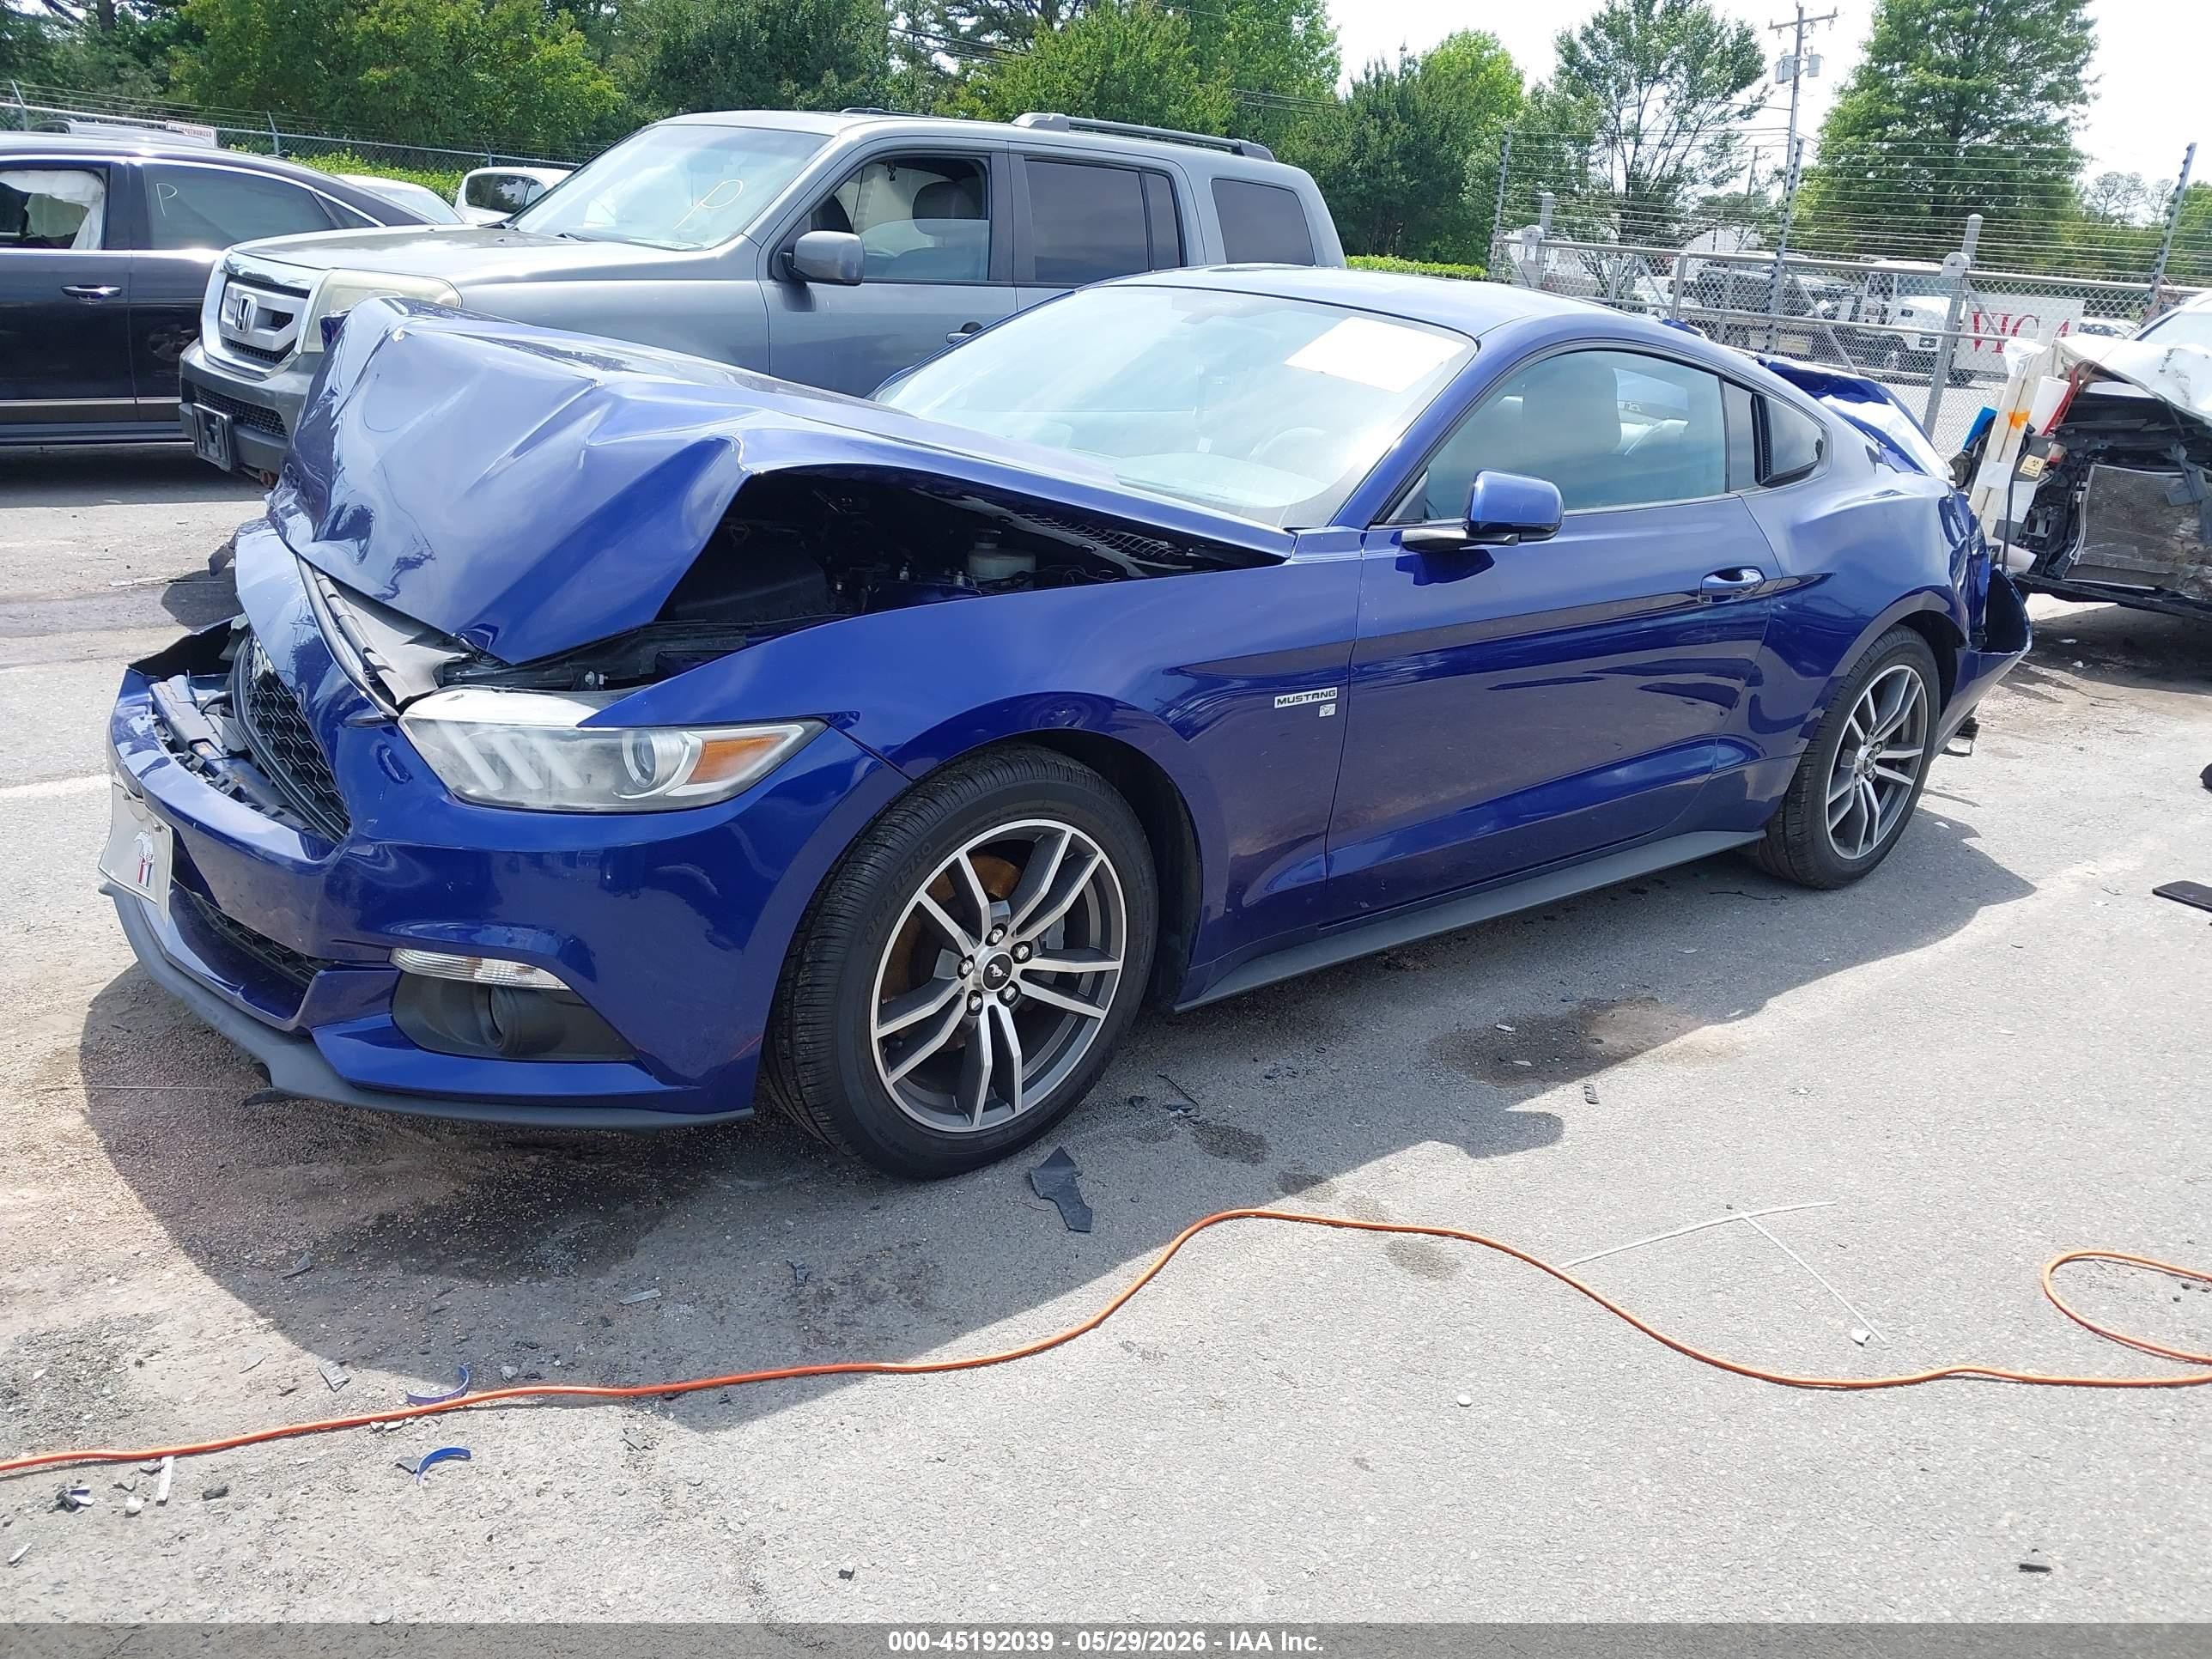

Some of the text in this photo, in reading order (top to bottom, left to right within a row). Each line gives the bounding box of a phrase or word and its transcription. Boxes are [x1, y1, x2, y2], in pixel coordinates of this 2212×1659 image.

[155, 182, 178, 217] P
[672, 179, 744, 230] P
[1276, 690, 1336, 706] MUSTANG
